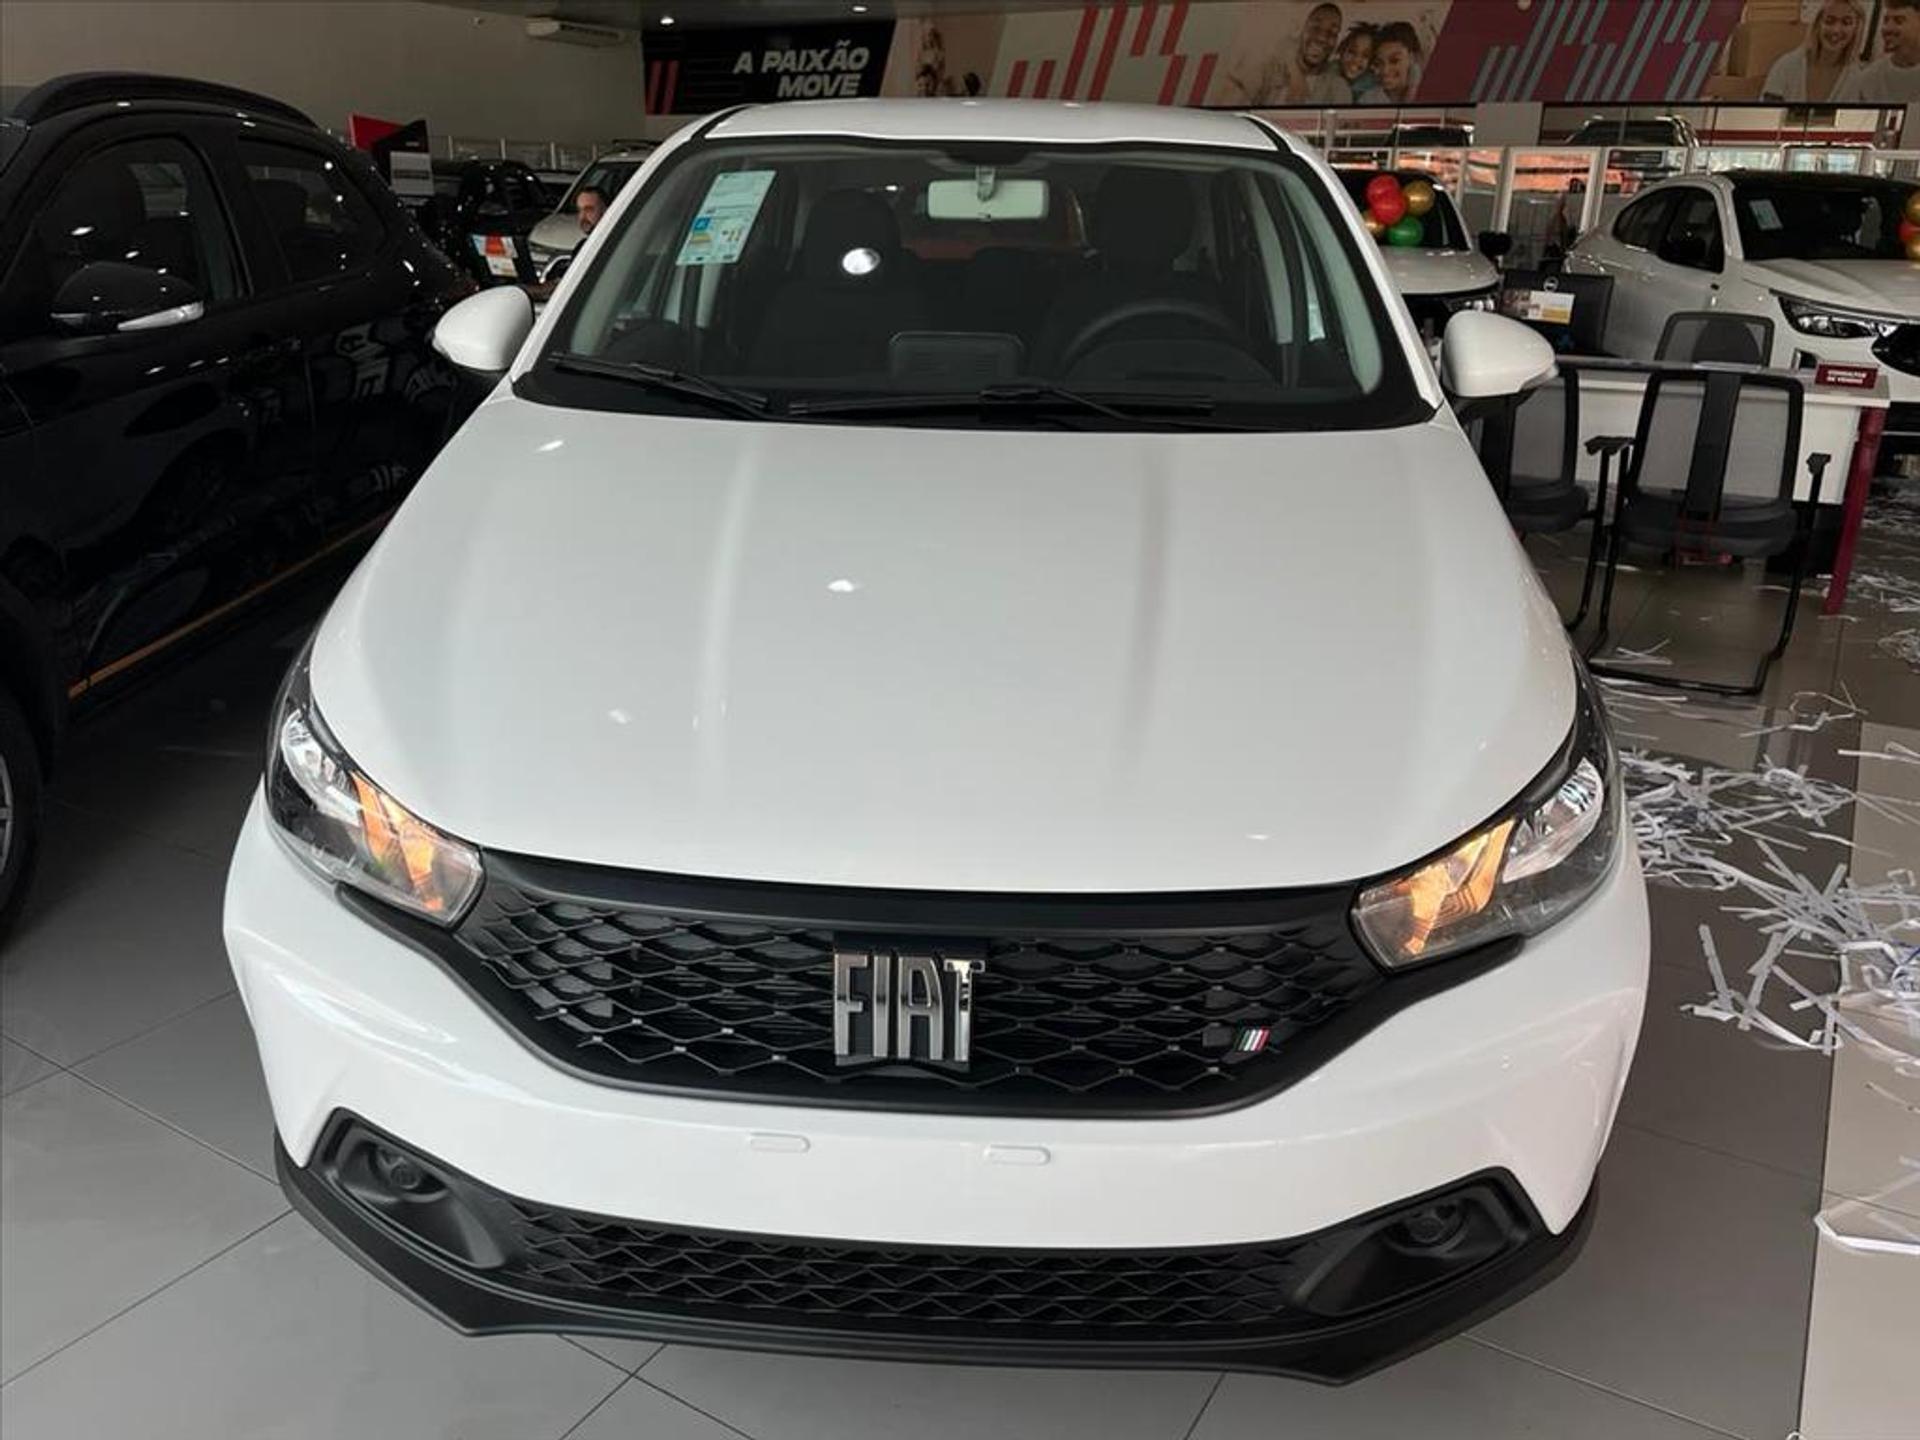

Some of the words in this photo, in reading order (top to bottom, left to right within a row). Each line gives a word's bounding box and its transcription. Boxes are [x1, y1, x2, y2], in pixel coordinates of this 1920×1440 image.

[733, 51, 753, 74] A
[761, 40, 870, 73] PAIXÃO
[777, 73, 861, 97] MOVE
[834, 954, 986, 1062] FIAT
